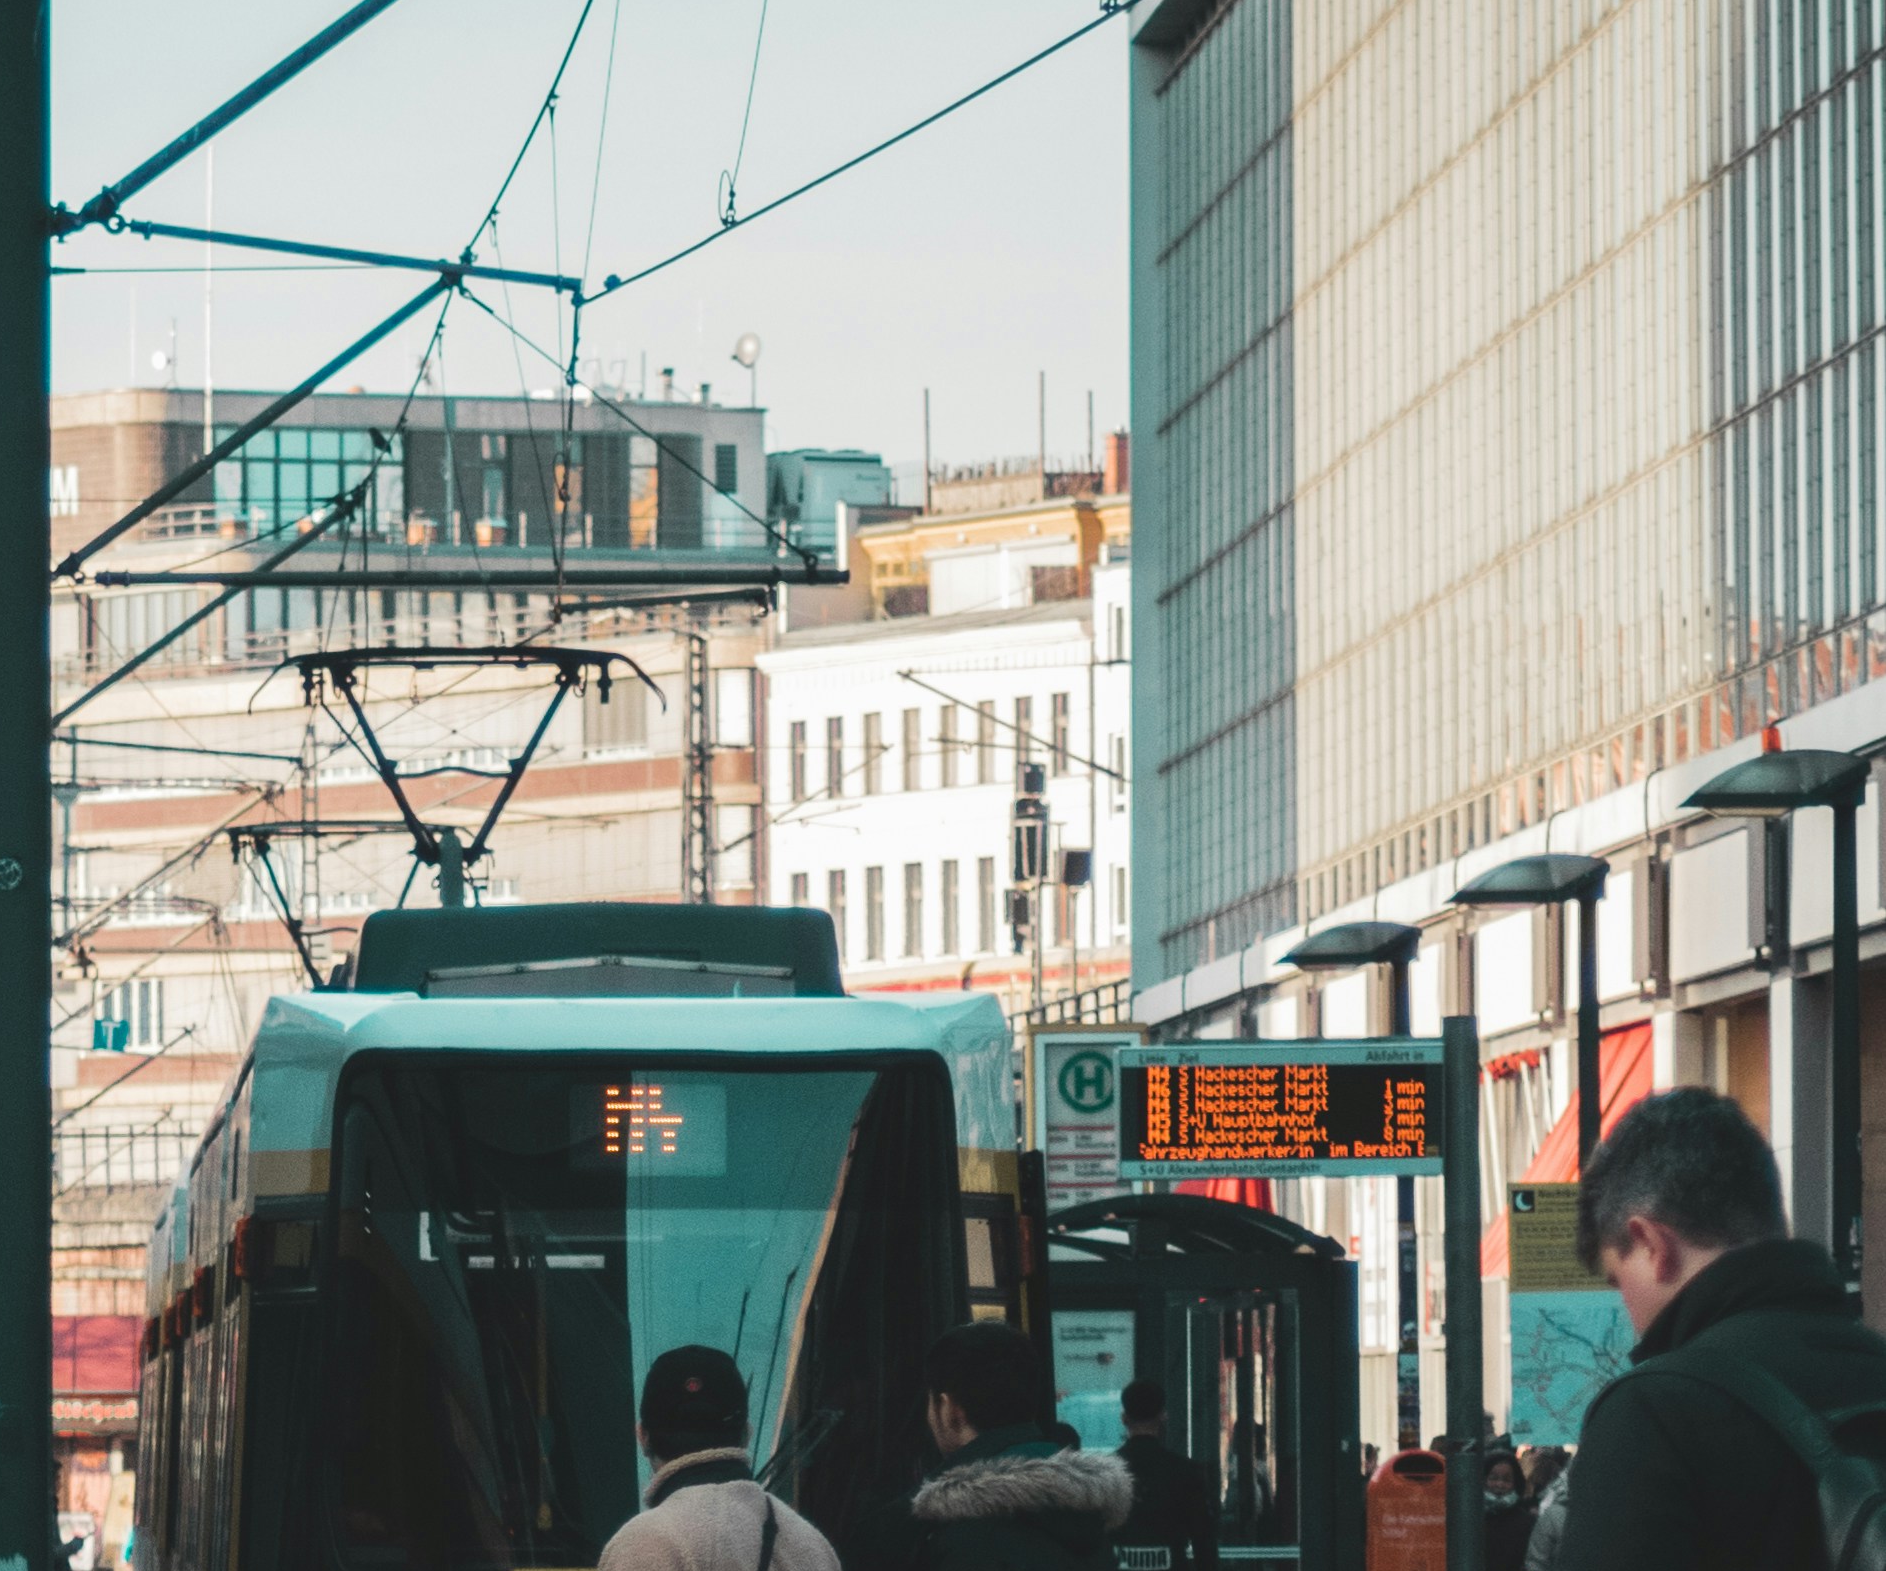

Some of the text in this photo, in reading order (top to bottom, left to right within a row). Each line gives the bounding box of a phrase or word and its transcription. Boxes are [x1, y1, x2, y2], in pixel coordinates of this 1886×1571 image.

[1285, 1064, 1328, 1080] Markt
[1285, 1080, 1328, 1096] Markt
[1285, 1096, 1328, 1111] Markt
[1285, 1127, 1328, 1143] Markt
